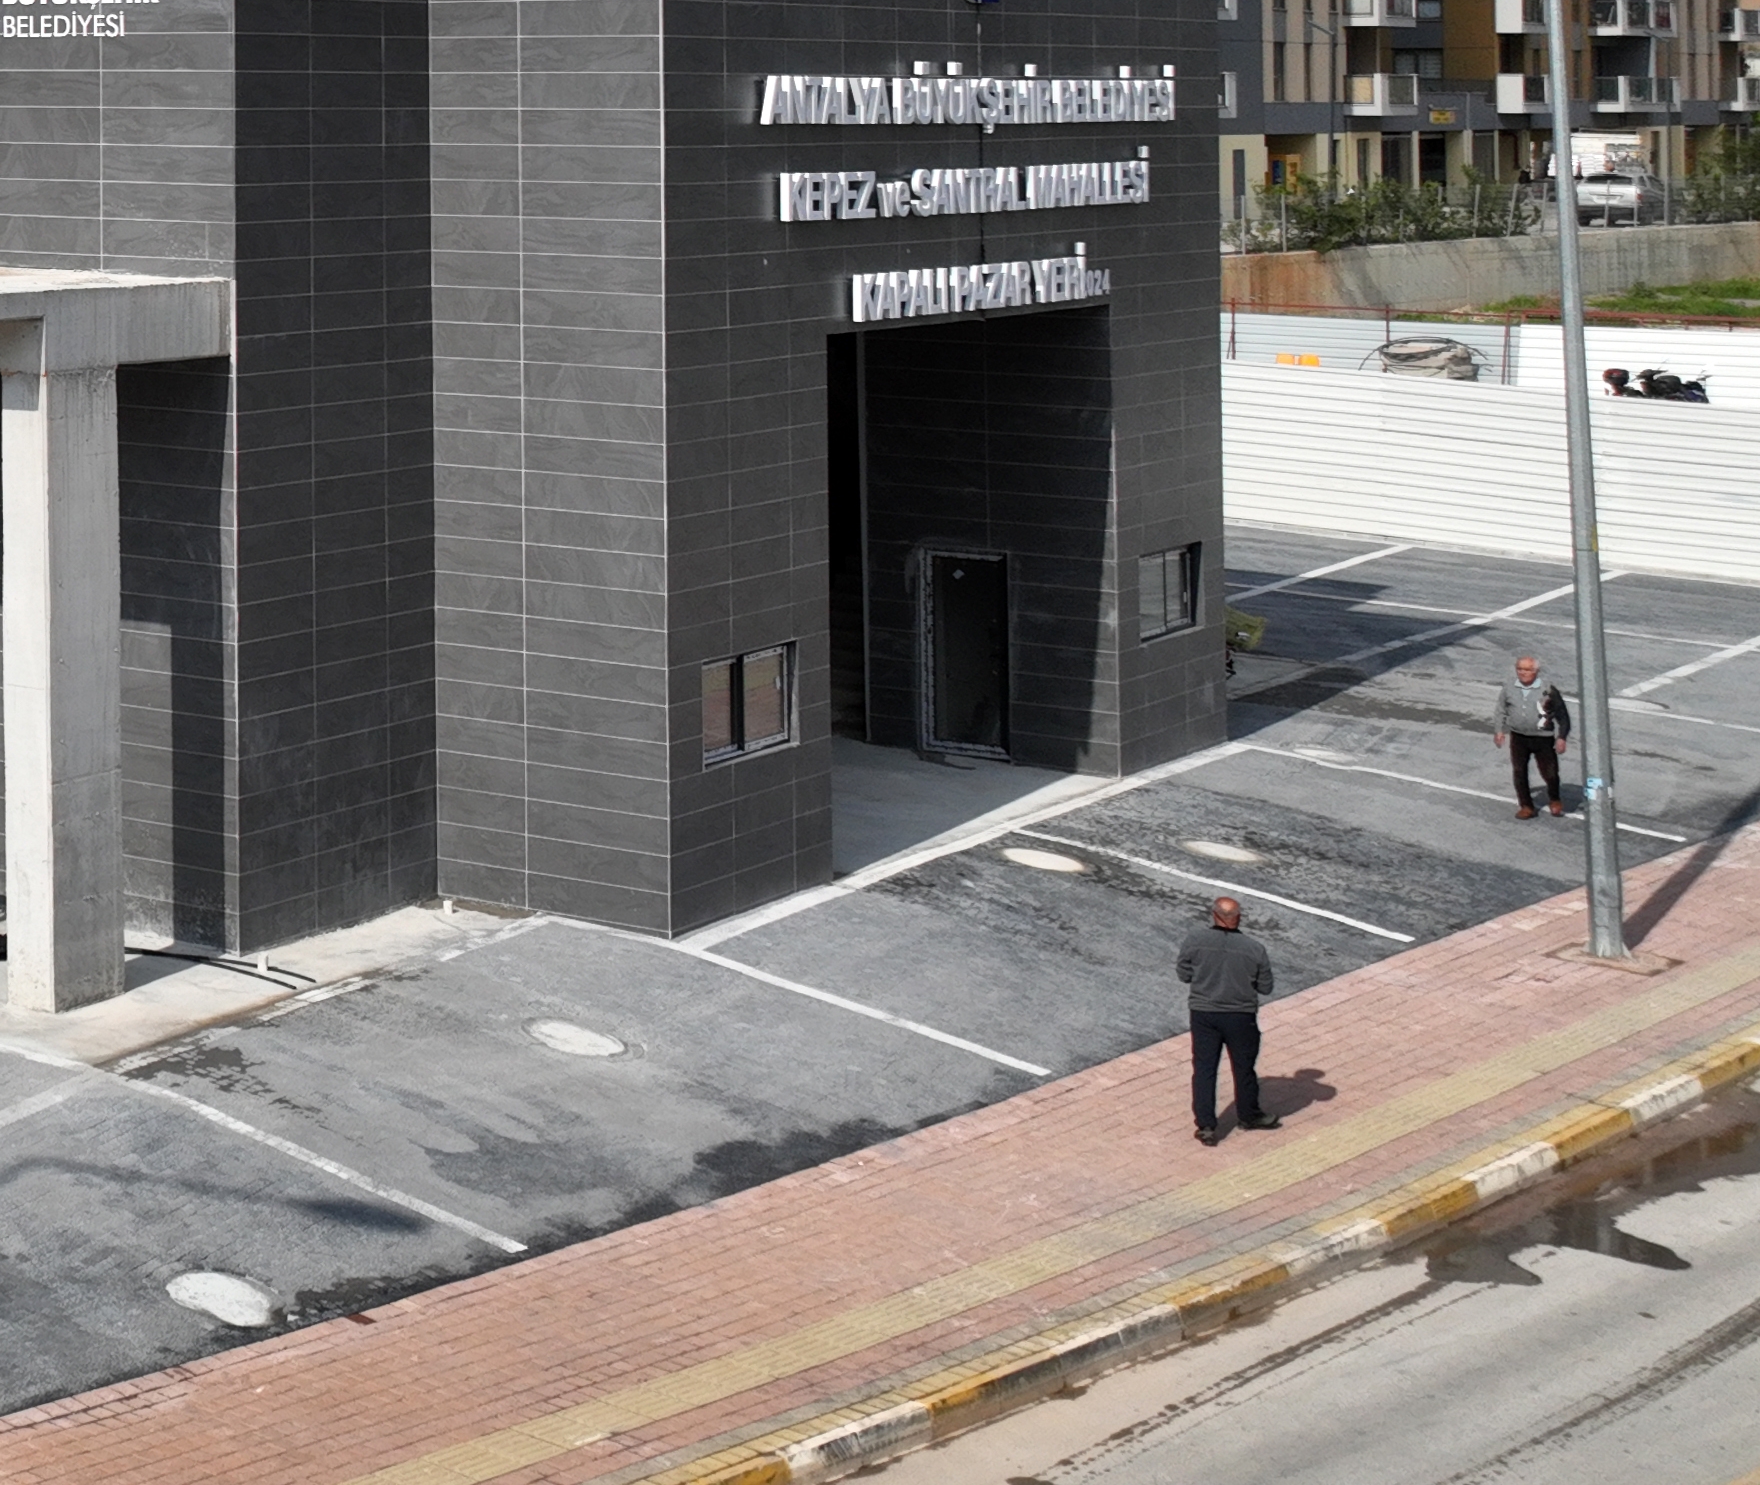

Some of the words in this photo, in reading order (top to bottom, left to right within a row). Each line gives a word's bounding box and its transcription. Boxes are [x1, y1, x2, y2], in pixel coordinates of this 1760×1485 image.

[2, 11, 126, 38] BELEDİYESİ
[760, 75, 892, 125] ANTALYA
[892, 61, 1053, 133] BÜYÜKŞEHİR
[1052, 64, 1176, 122] BELEDİYESİ
[780, 171, 877, 222] KEPEZ
[877, 181, 911, 218] ve
[911, 167, 1026, 216] SANTRAL
[1026, 145, 1151, 209] MAHALLESİ
[852, 268, 949, 322] KAPALI
[950, 262, 1032, 312] PAZAR
[1032, 241, 1087, 305] YERİ
[1084, 268, 1112, 298] 024
